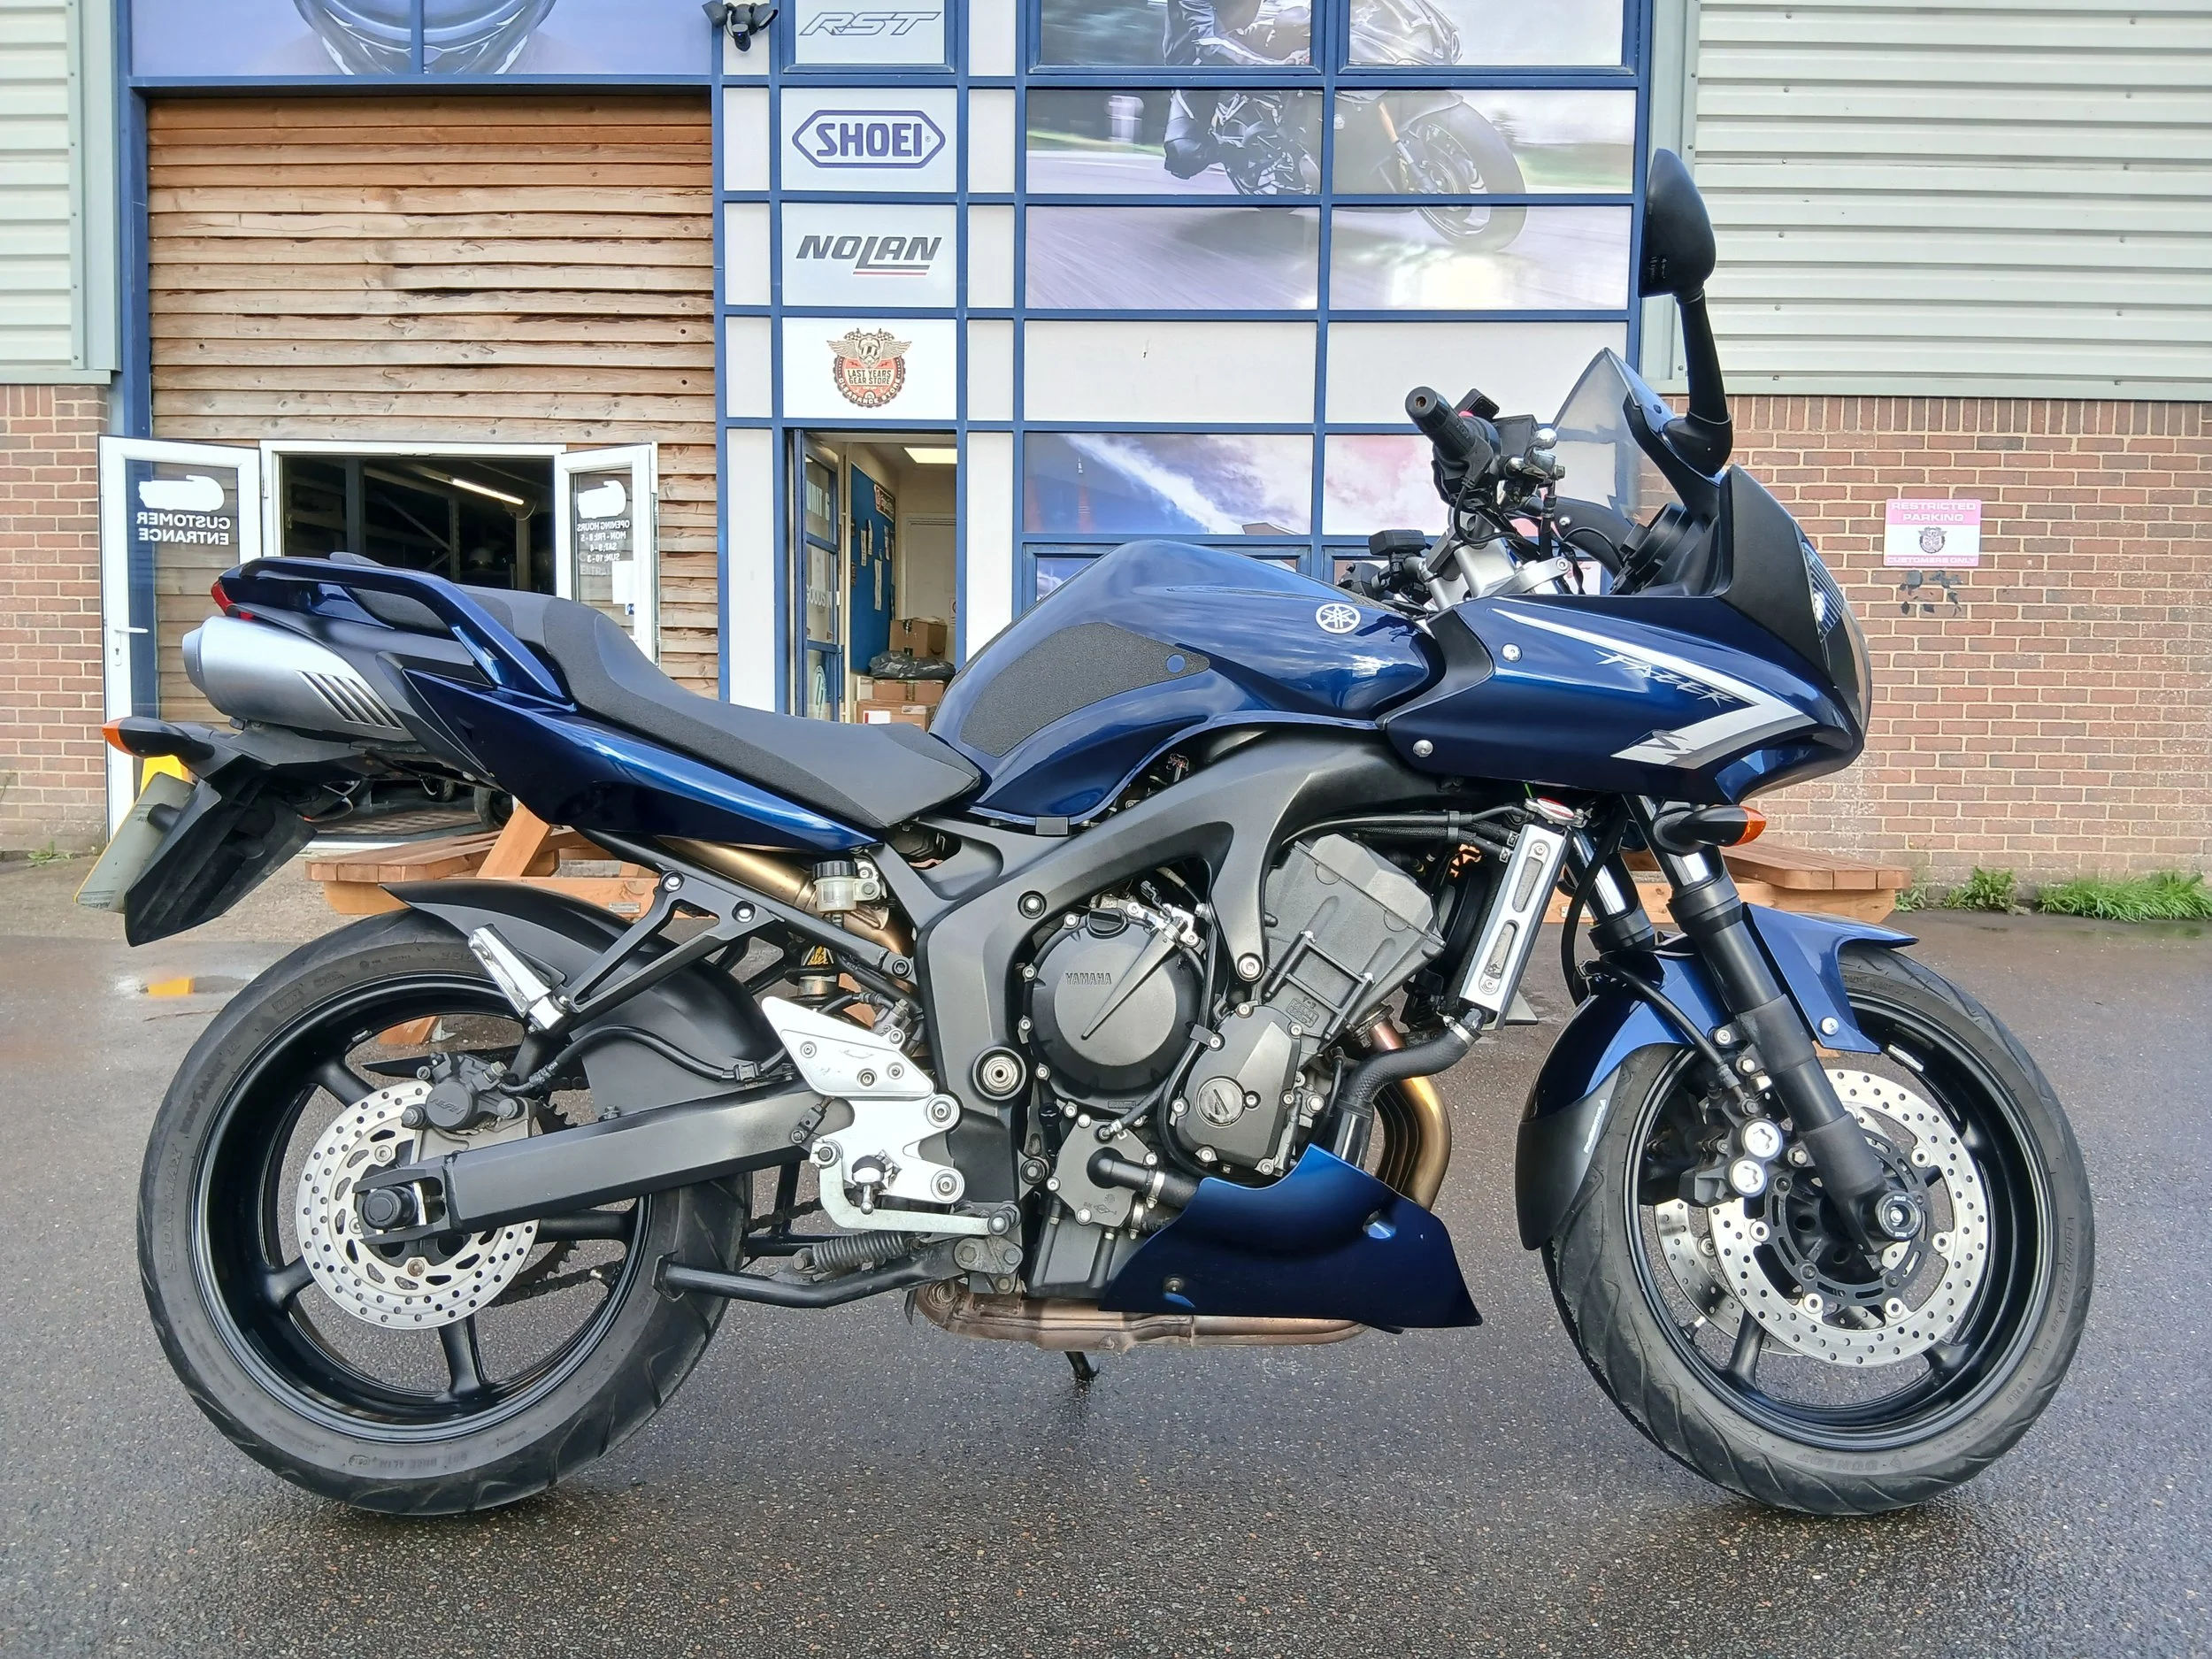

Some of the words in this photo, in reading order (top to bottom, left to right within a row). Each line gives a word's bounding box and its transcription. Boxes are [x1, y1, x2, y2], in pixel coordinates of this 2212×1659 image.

[798, 12, 941, 36] RST
[816, 123, 923, 157] SHOEI
[796, 235, 942, 270] NOLAN
[838, 378, 879, 404] CLEARANCE
[1891, 502, 1977, 511] RESTRICTED
[1902, 513, 1964, 522] PARKING
[1064, 972, 1112, 985] YAMAHA
